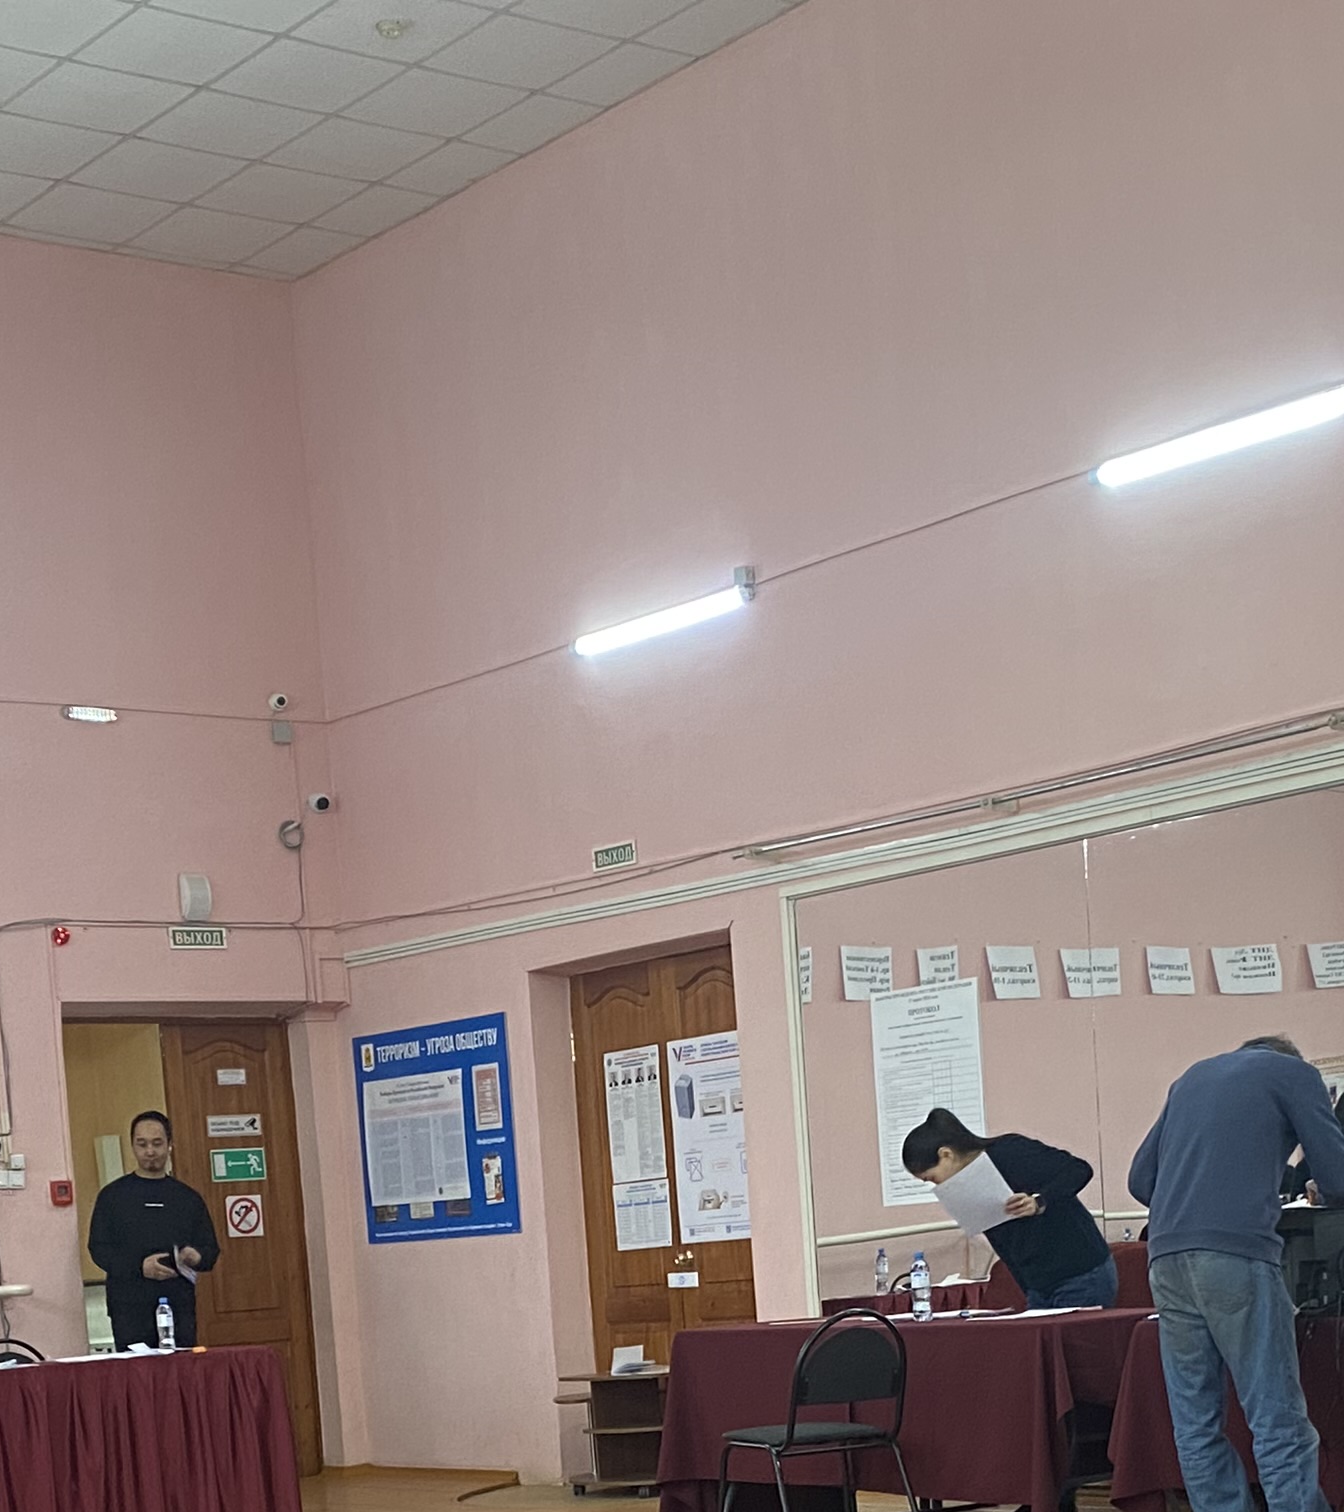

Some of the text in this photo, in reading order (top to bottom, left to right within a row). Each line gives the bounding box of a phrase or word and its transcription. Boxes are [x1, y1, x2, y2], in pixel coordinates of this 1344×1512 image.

[597, 846, 633, 867] ВЫХОД
[175, 931, 222, 945] ВЫХОД
[376, 1040, 420, 1063] ТЕРРОРИЗМ
[426, 1035, 455, 1056] УГРОЗА
[455, 1027, 497, 1051] ОБЩЕСТВУ
